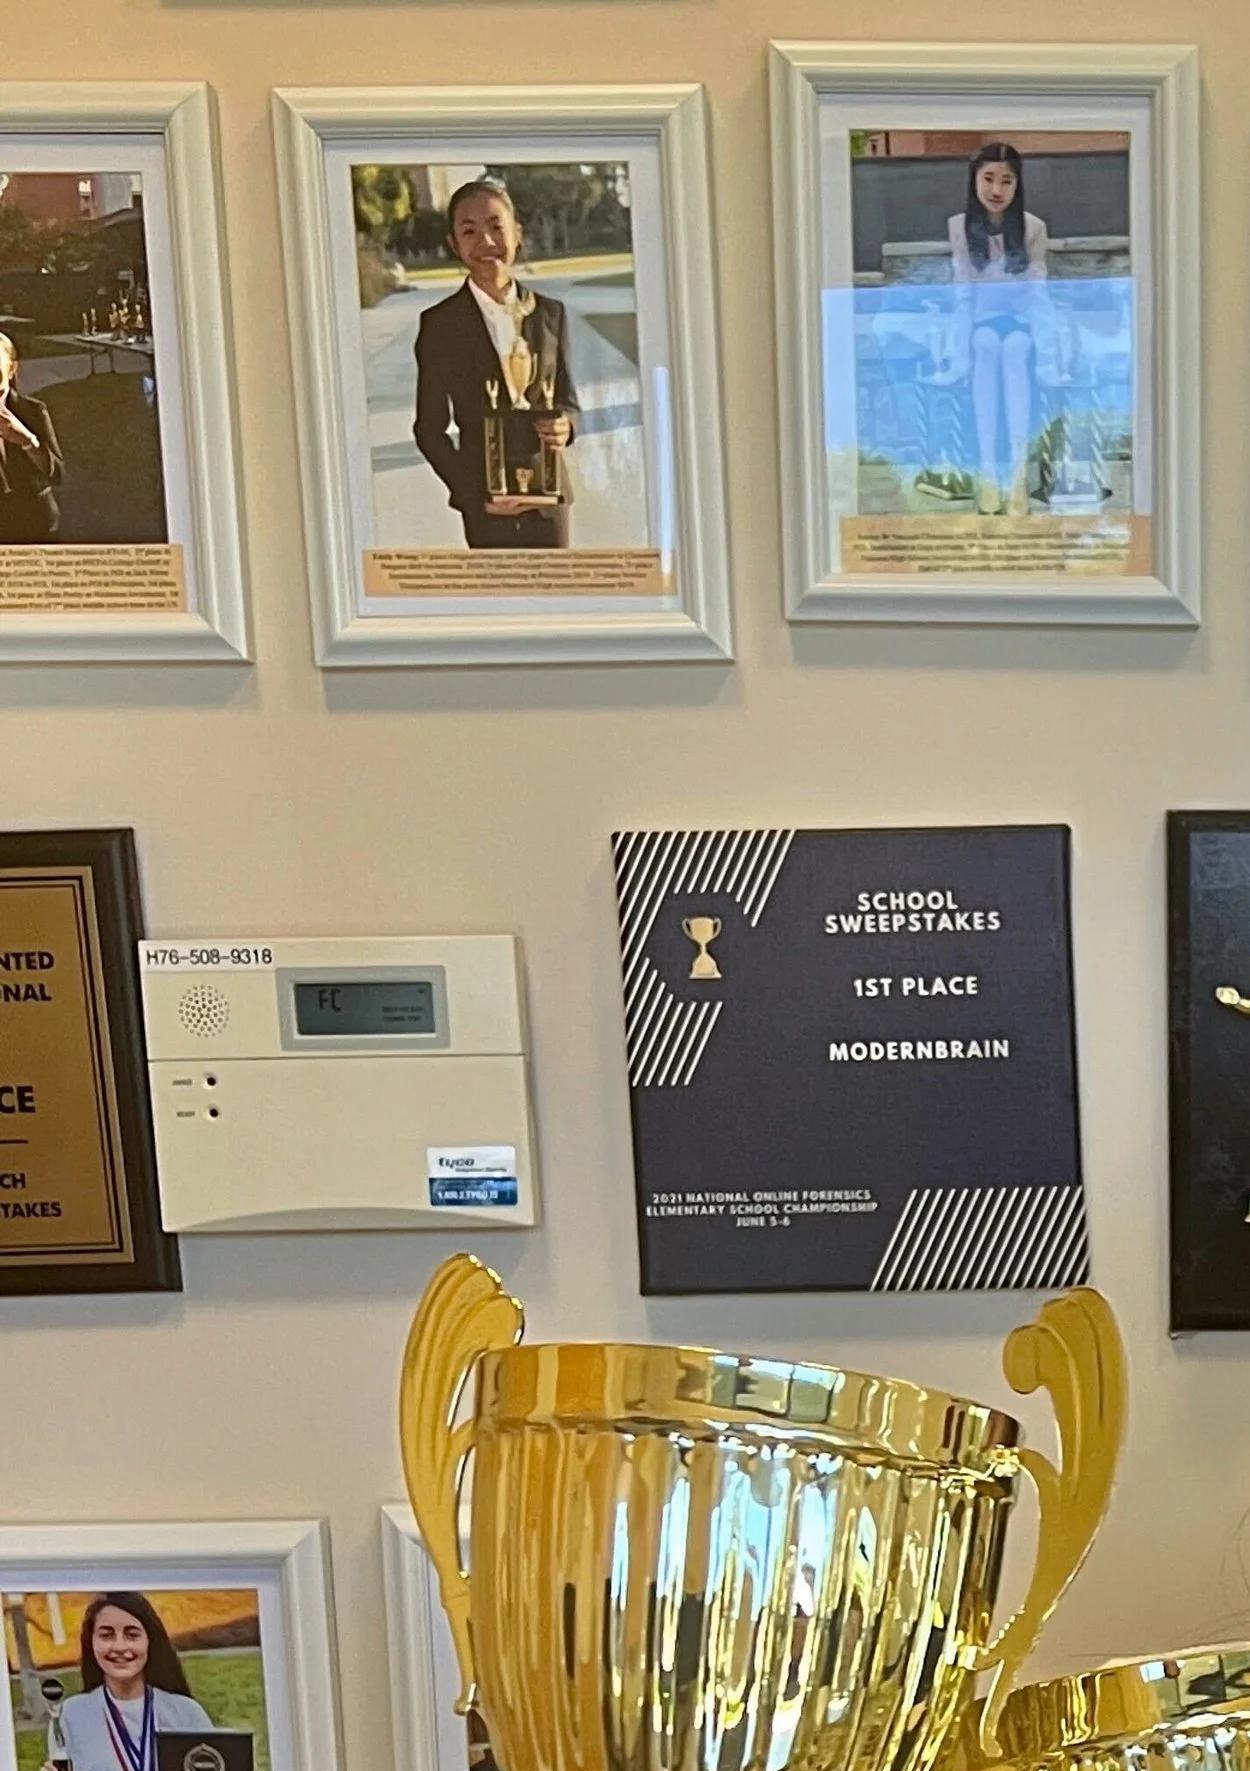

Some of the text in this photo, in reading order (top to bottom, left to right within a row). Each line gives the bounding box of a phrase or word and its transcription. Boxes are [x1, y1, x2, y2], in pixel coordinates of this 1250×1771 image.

[857, 890, 959, 912] SCHOOL
[824, 911, 1001, 934] SWEEPSTAKES
[147, 949, 272, 965] H76-508-9318
[853, 976, 978, 997] 1ST PLACE
[829, 1039, 1010, 1061] MODERNBRAIN
[652, 1189, 871, 1204] 2021 NATIONAL ONLINE FORENSICS
[646, 1202, 879, 1217] ELEMENTARY SCHOOL CHAMPIONSHIP
[736, 1215, 791, 1227] JUNE 5-6
